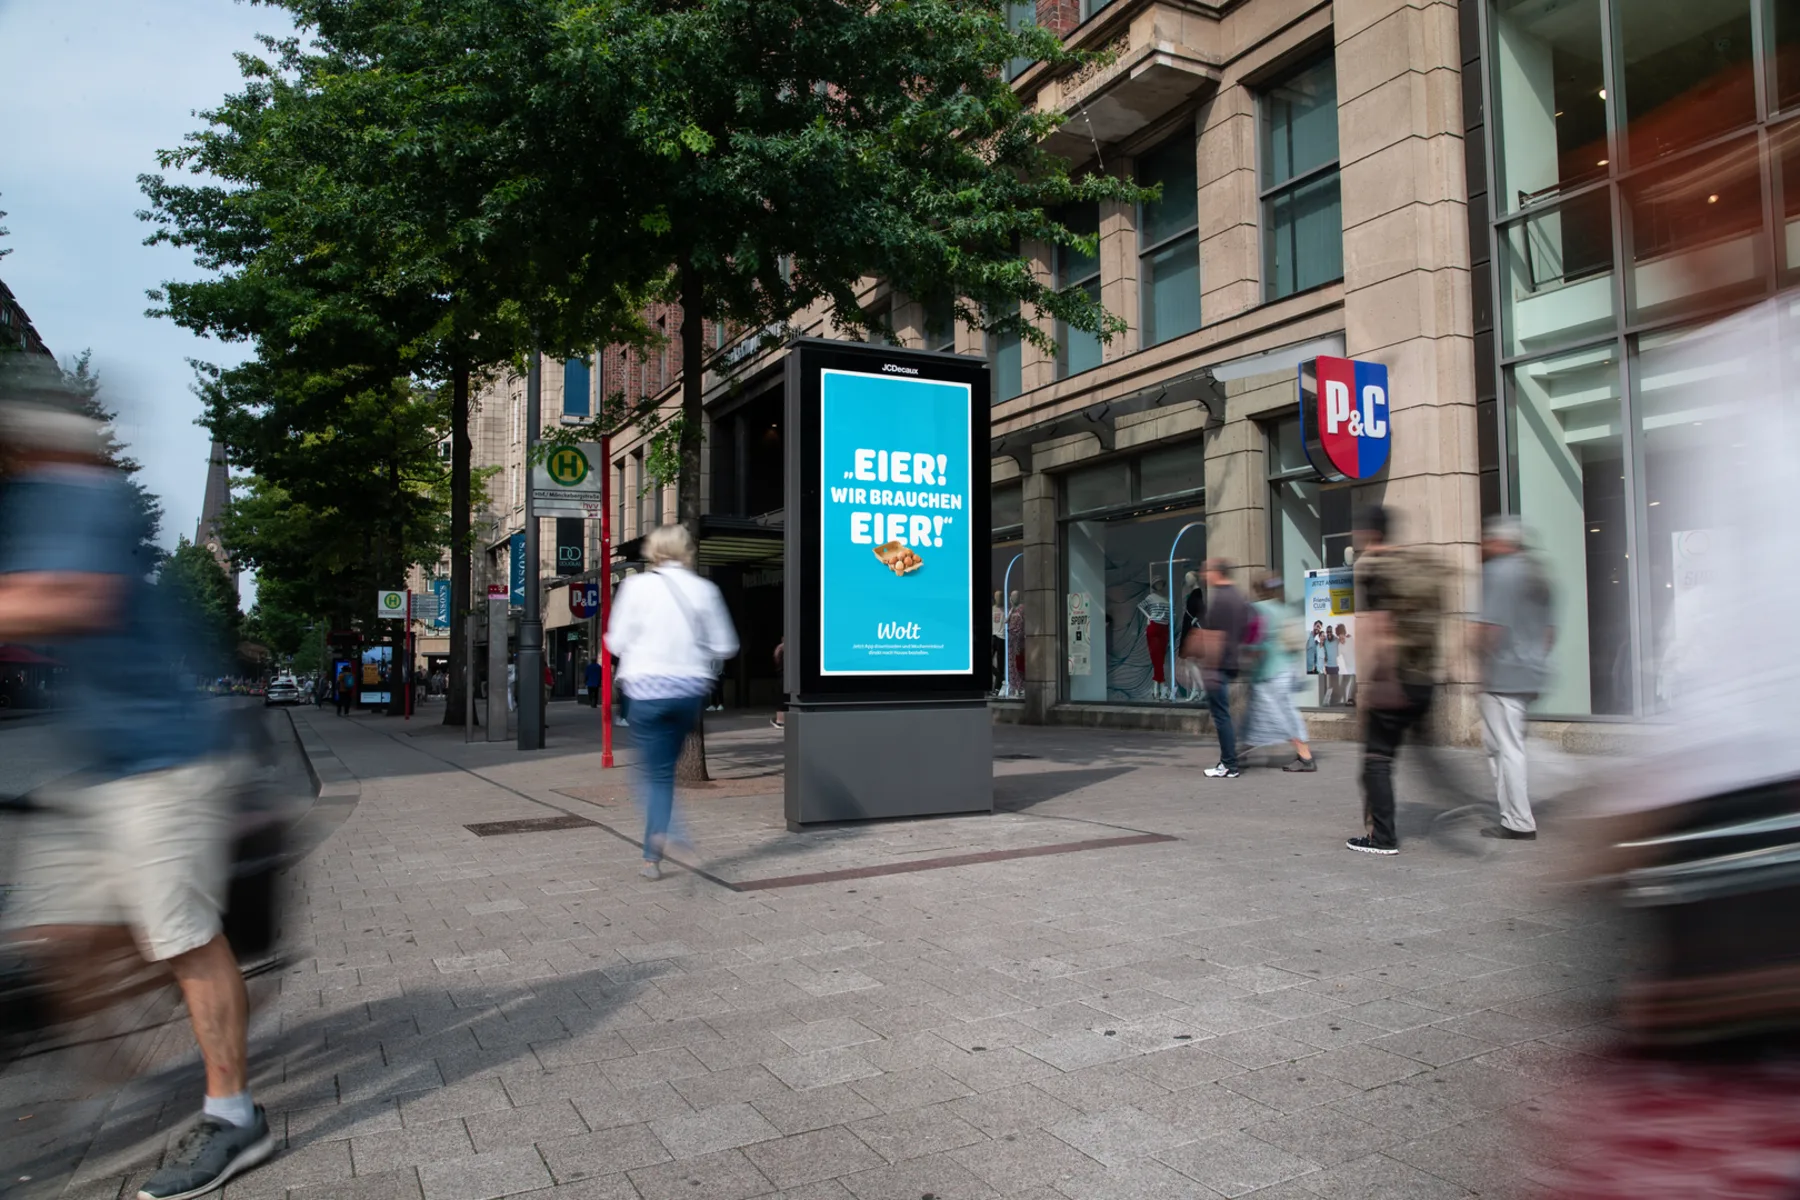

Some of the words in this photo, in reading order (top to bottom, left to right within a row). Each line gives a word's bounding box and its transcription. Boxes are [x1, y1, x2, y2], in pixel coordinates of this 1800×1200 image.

[882, 363, 919, 375] JCDecaux
[1325, 380, 1387, 439] P&C
[558, 454, 578, 478] H
[843, 448, 948, 486] „EIER!
[830, 486, 867, 505] WIR
[869, 489, 962, 510] BRAUCHEN
[850, 511, 953, 548] EIER!“
[572, 589, 598, 607] P&C
[877, 620, 922, 640] Wolt
[1071, 615, 1088, 626] SPORT
